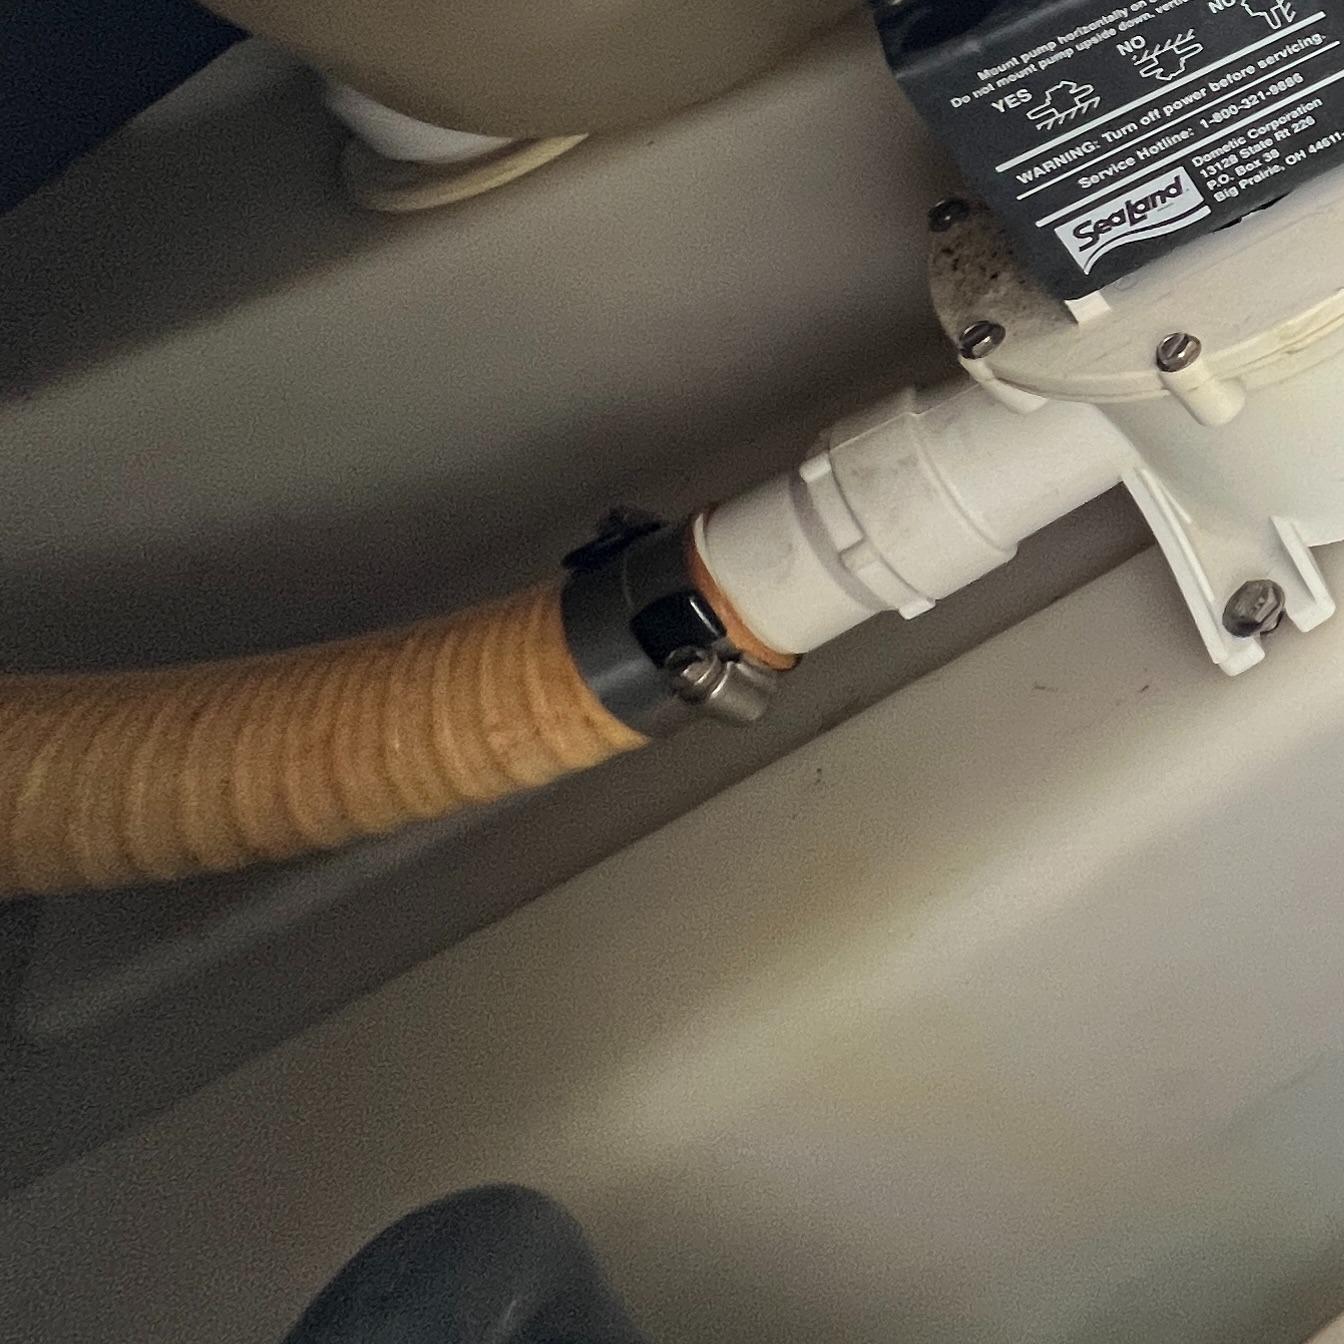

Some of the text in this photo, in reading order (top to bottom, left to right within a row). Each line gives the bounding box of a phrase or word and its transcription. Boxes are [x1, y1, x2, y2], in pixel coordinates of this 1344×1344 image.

[950, 95, 971, 108] Do
[972, 83, 995, 98] not
[996, 64, 1038, 87] mount
[1038, 48, 1074, 70] pump
[1075, 28, 1117, 51] upside
[977, 57, 1020, 81] Mount
[1019, 41, 1057, 64] pump
[1130, 0, 1147, 11] on
[1116, 36, 1146, 56] NO
[991, 89, 1032, 112] YES
[1016, 33, 1326, 184] WARNING: Turn off power before servicing.
[1078, 157, 1136, 188] Service
[1136, 128, 1194, 160] Hotline:
[1191, 99, 1323, 167] Dometic Corporation
[1239, 138, 1273, 159] State
[1213, 186, 1239, 202] Big
[1285, 149, 1307, 165] OH
[1234, 159, 1263, 176] Box
